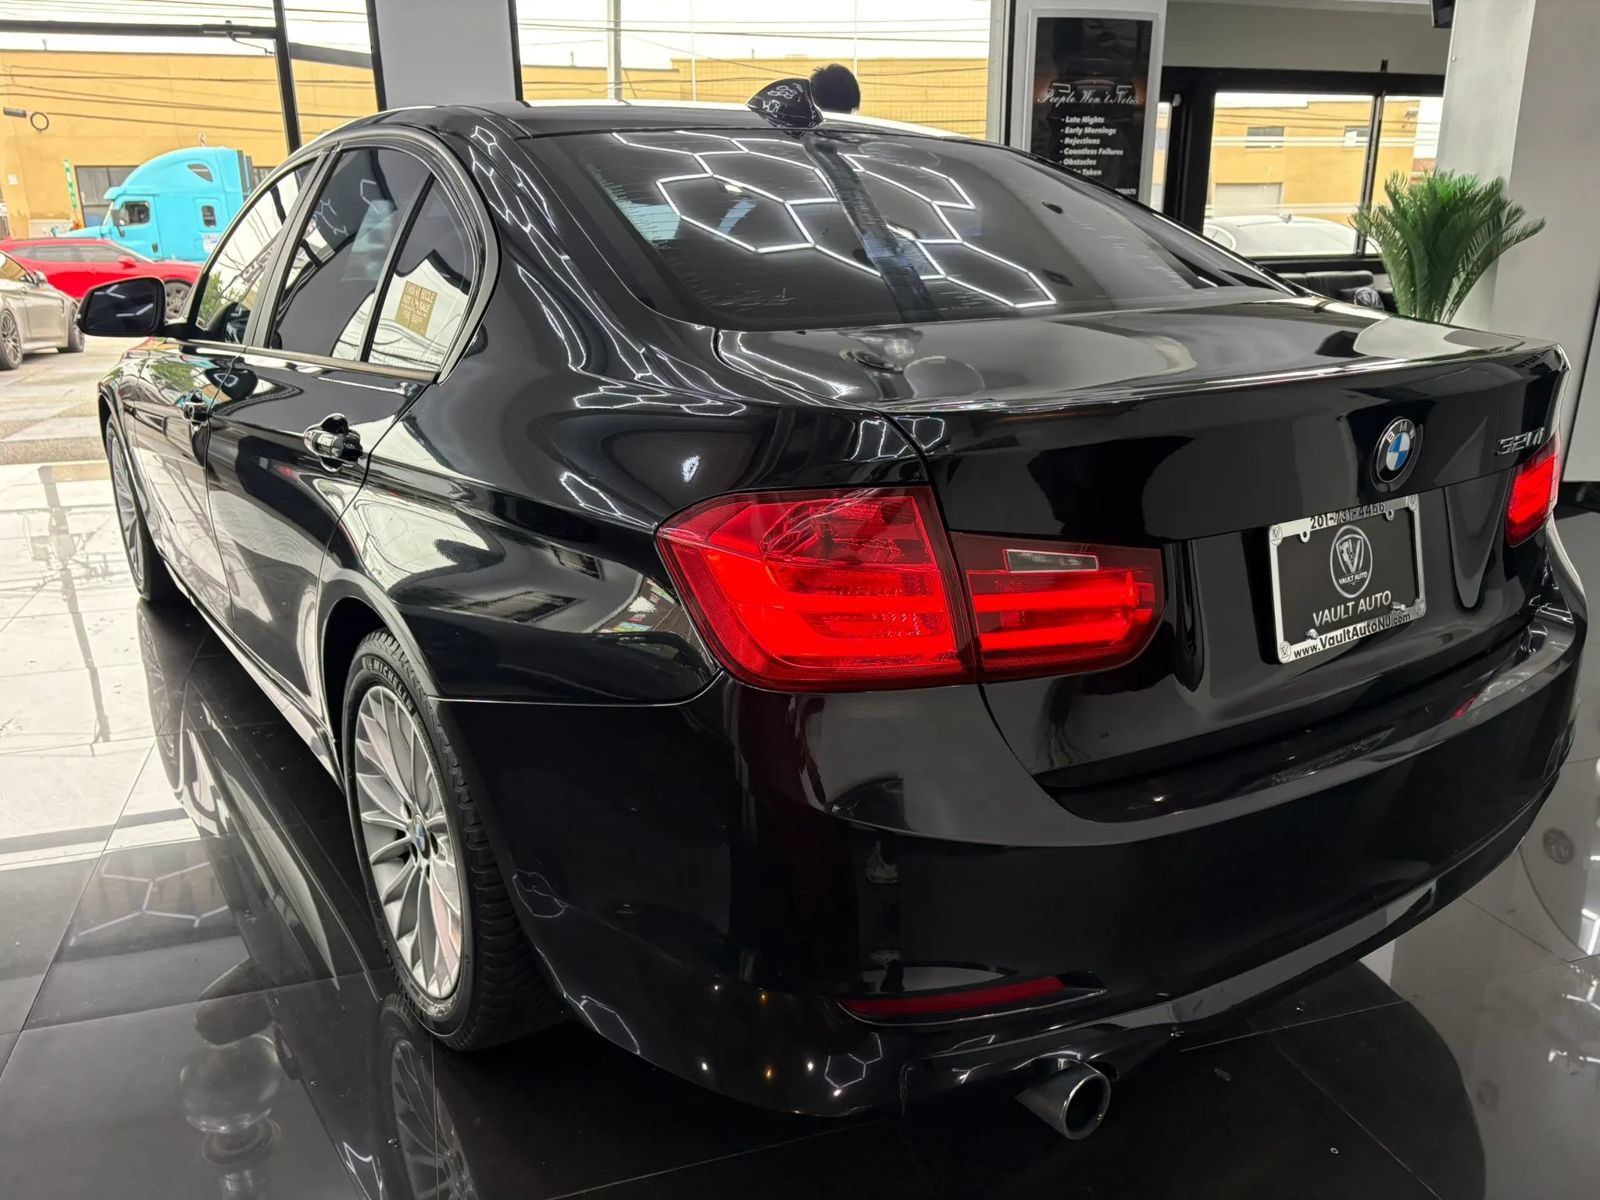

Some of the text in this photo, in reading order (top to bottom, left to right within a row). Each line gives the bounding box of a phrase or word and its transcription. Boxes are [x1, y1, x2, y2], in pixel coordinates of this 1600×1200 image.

[1037, 88, 1077, 108] People
[1082, 116, 1105, 125] Nights
[1064, 126, 1117, 136] Early Mornings
[1064, 137, 1100, 146] Rejections
[1063, 147, 1124, 156] Countless Failures
[1063, 158, 1097, 166] Obstacles
[1082, 168, 1102, 176] Taken
[1338, 571, 1368, 585] VAULT AUTO
[1312, 590, 1392, 628] VAULT AUTO
[373, 659, 414, 712] MICHELIN
